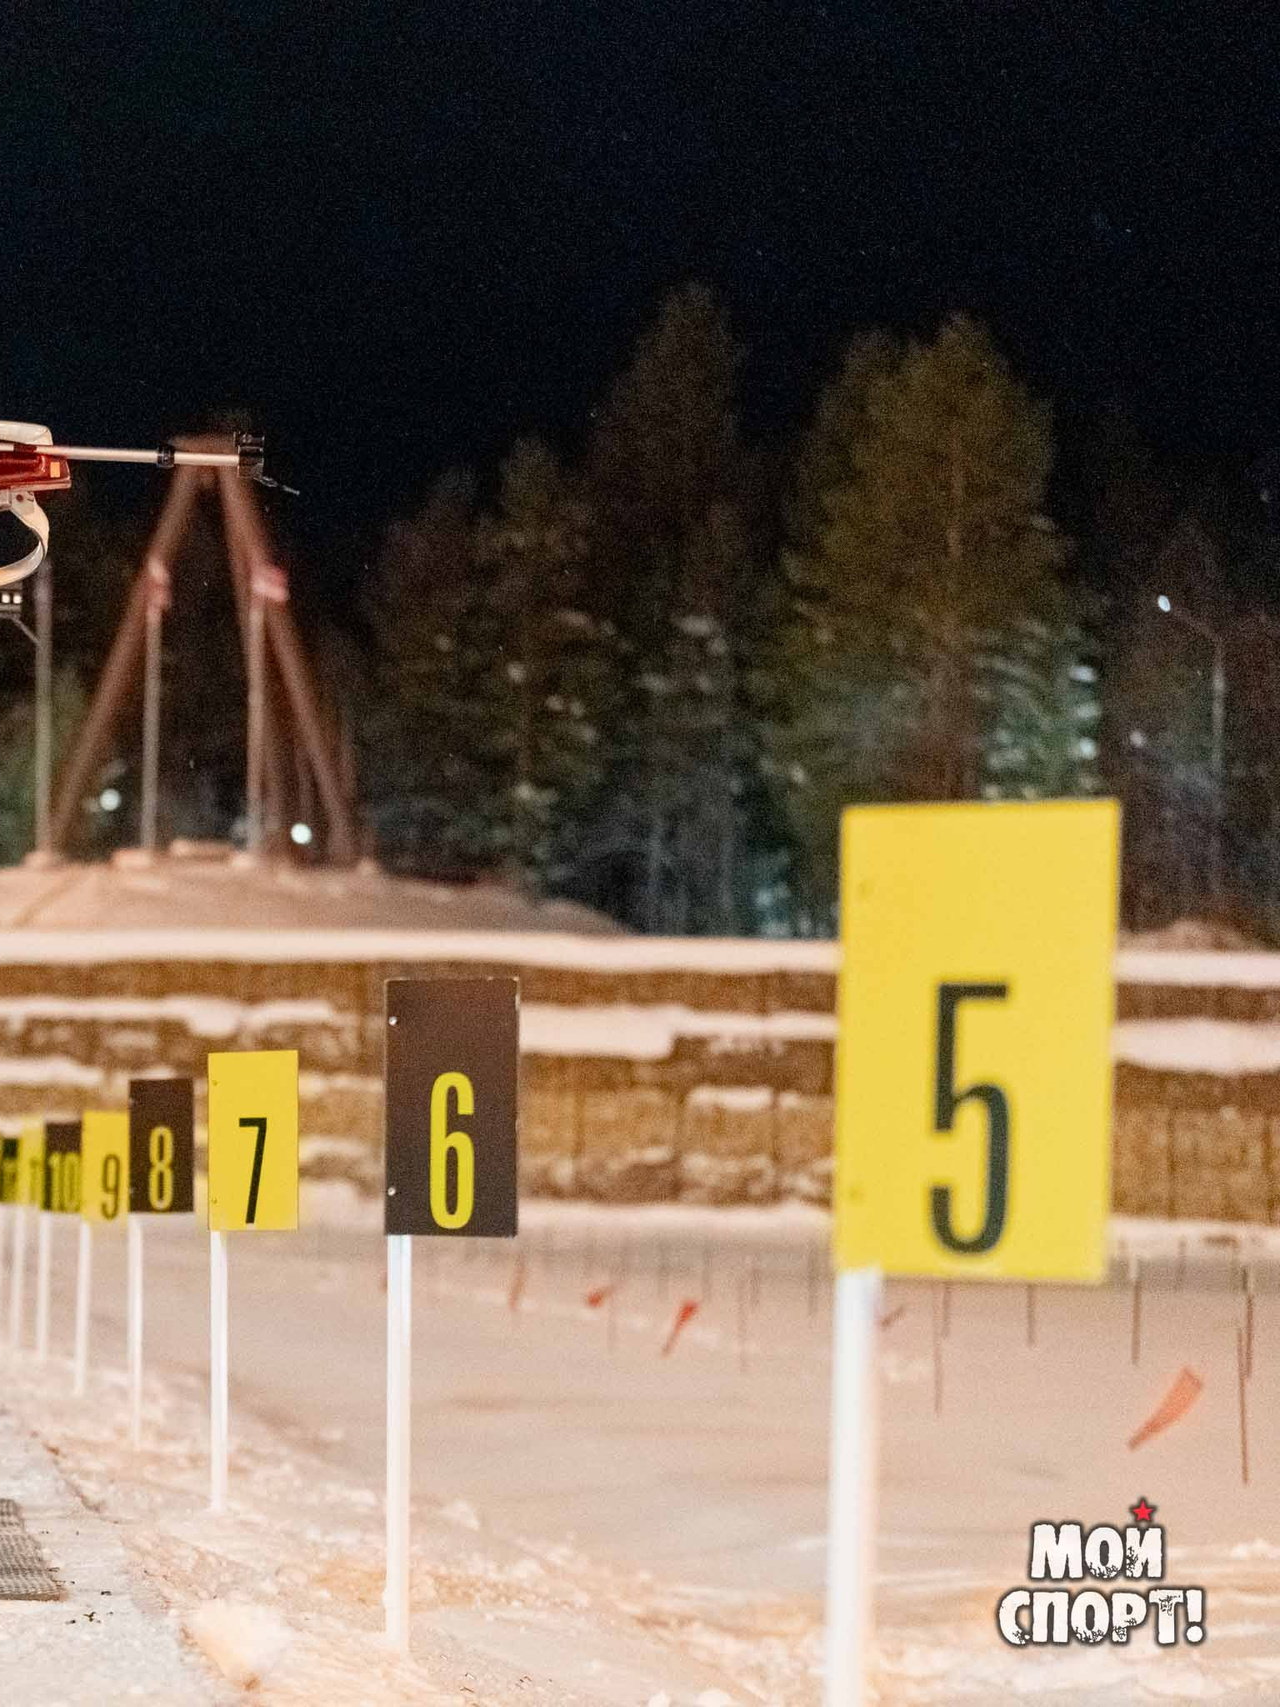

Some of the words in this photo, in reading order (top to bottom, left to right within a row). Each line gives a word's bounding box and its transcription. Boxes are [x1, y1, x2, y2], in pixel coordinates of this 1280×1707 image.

[149, 1125, 173, 1211] 8
[239, 1117, 267, 1224] 7
[429, 1071, 475, 1230] 6
[930, 982, 1009, 1255] 5
[101, 1153, 121, 1220] 9
